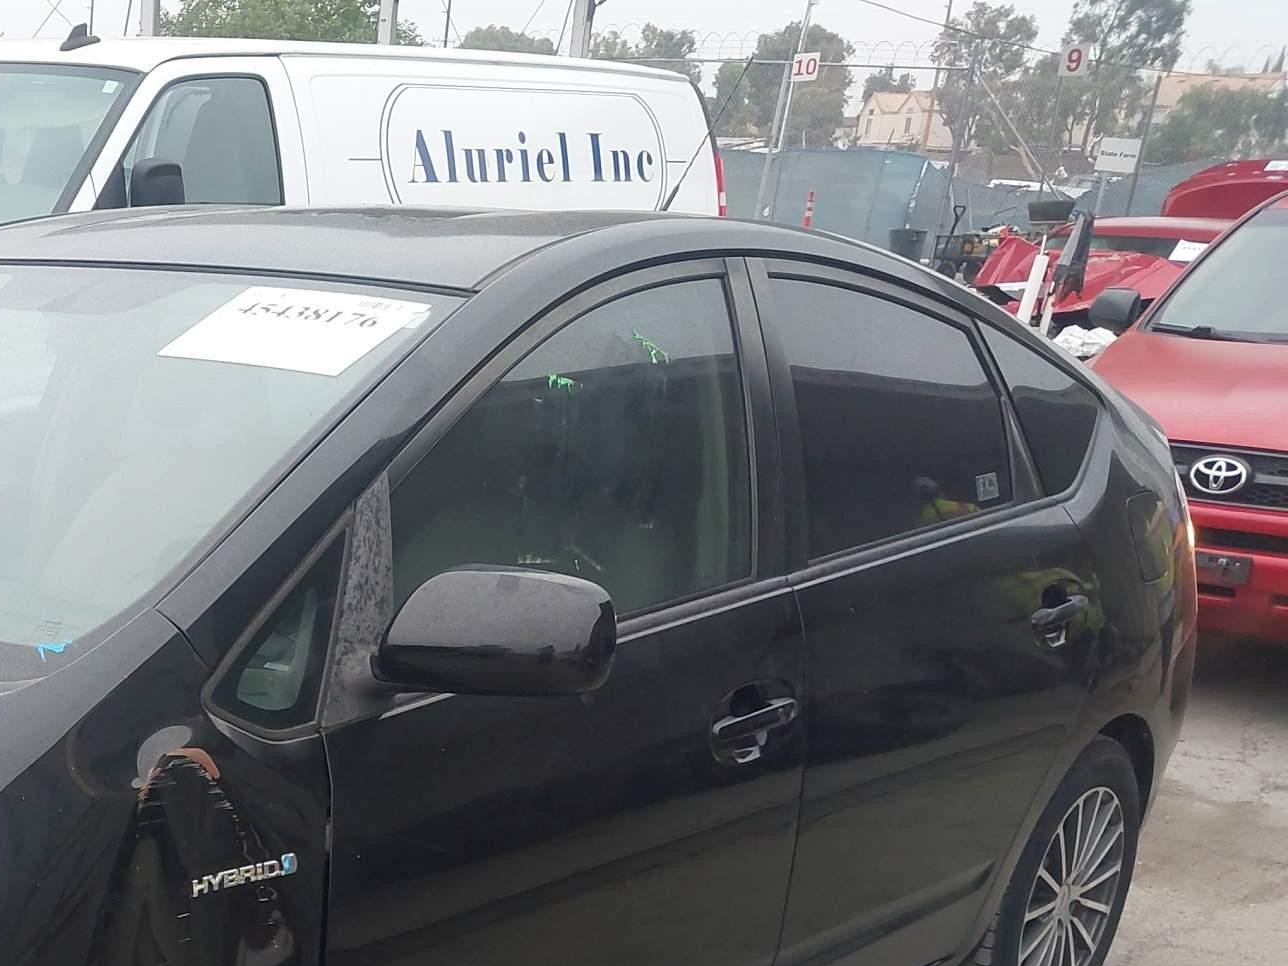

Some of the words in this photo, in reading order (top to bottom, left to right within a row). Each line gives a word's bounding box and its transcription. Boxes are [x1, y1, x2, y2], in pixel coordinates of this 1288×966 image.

[792, 57, 817, 76] 10
[1065, 48, 1083, 72] 9
[407, 129, 573, 184] Aluriel
[585, 132, 655, 183] Inc
[1100, 150, 1118, 158] State
[238, 302, 378, 328] 45438176
[191, 859, 280, 899] HYBRID
